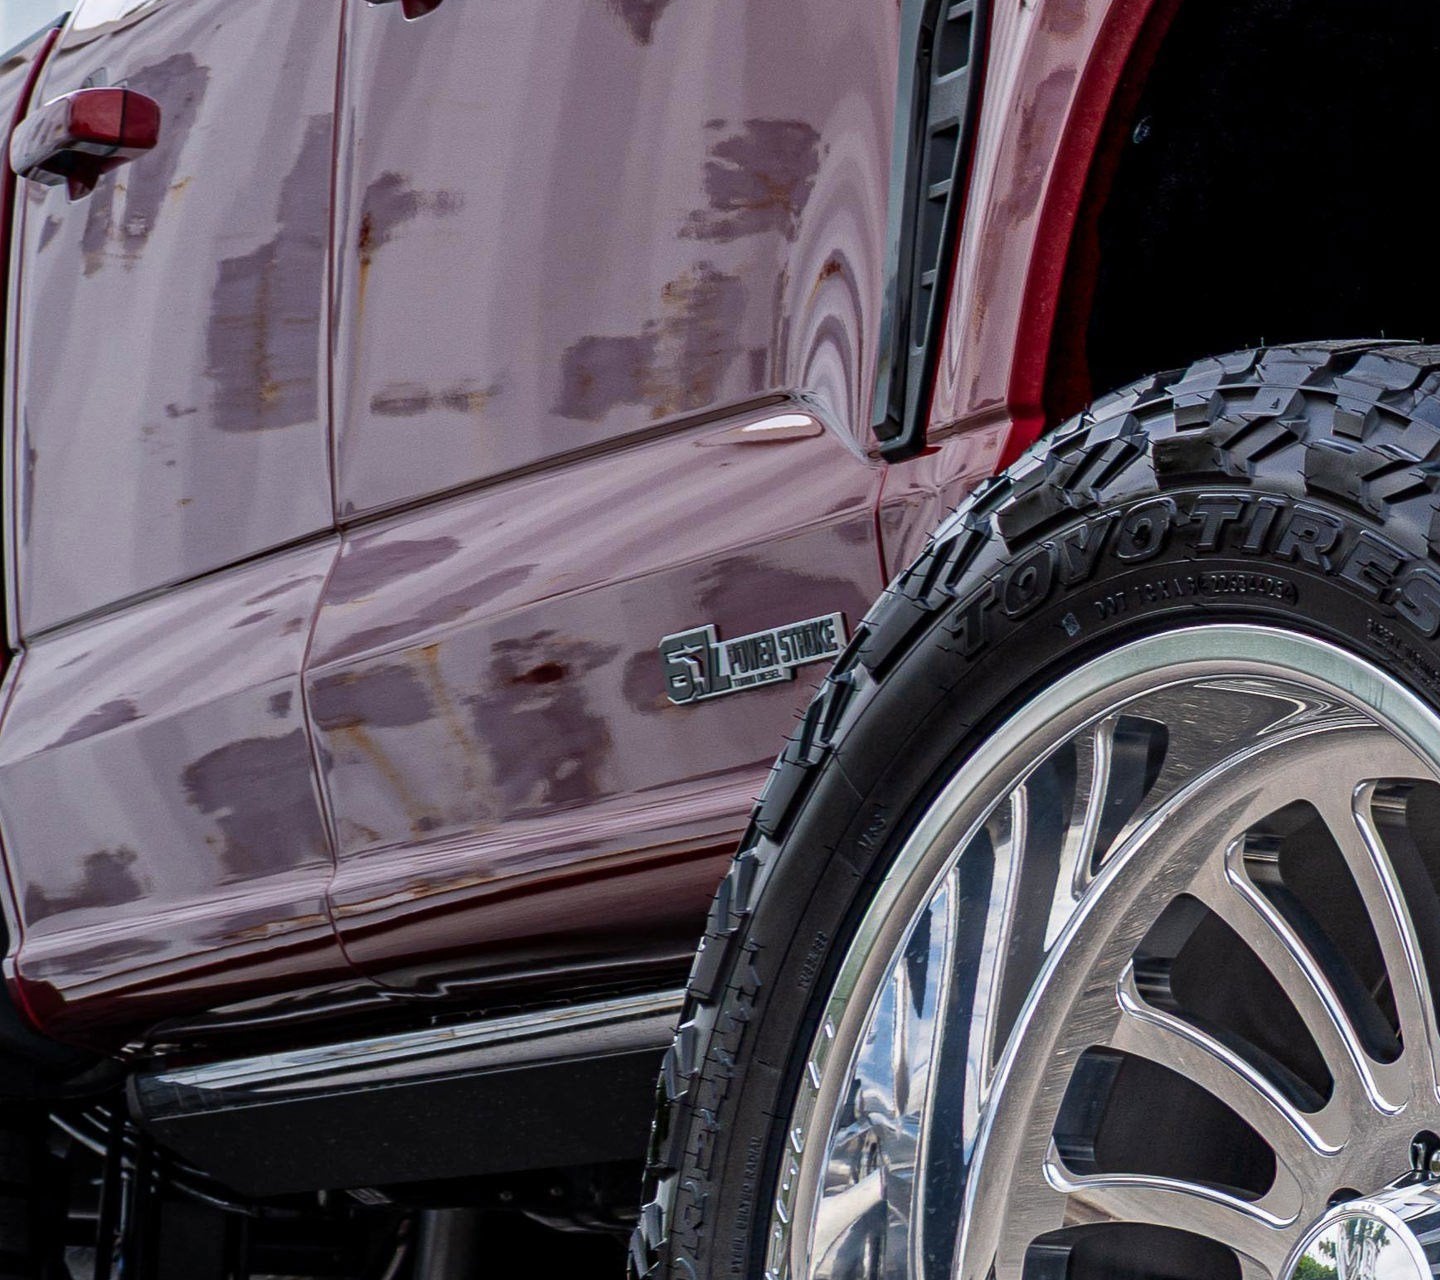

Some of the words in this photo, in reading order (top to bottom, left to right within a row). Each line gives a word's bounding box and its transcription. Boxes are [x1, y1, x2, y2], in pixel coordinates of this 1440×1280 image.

[953, 493, 1184, 662] TOYO
[726, 632, 780, 676] POWER
[777, 617, 839, 664] STROKE
